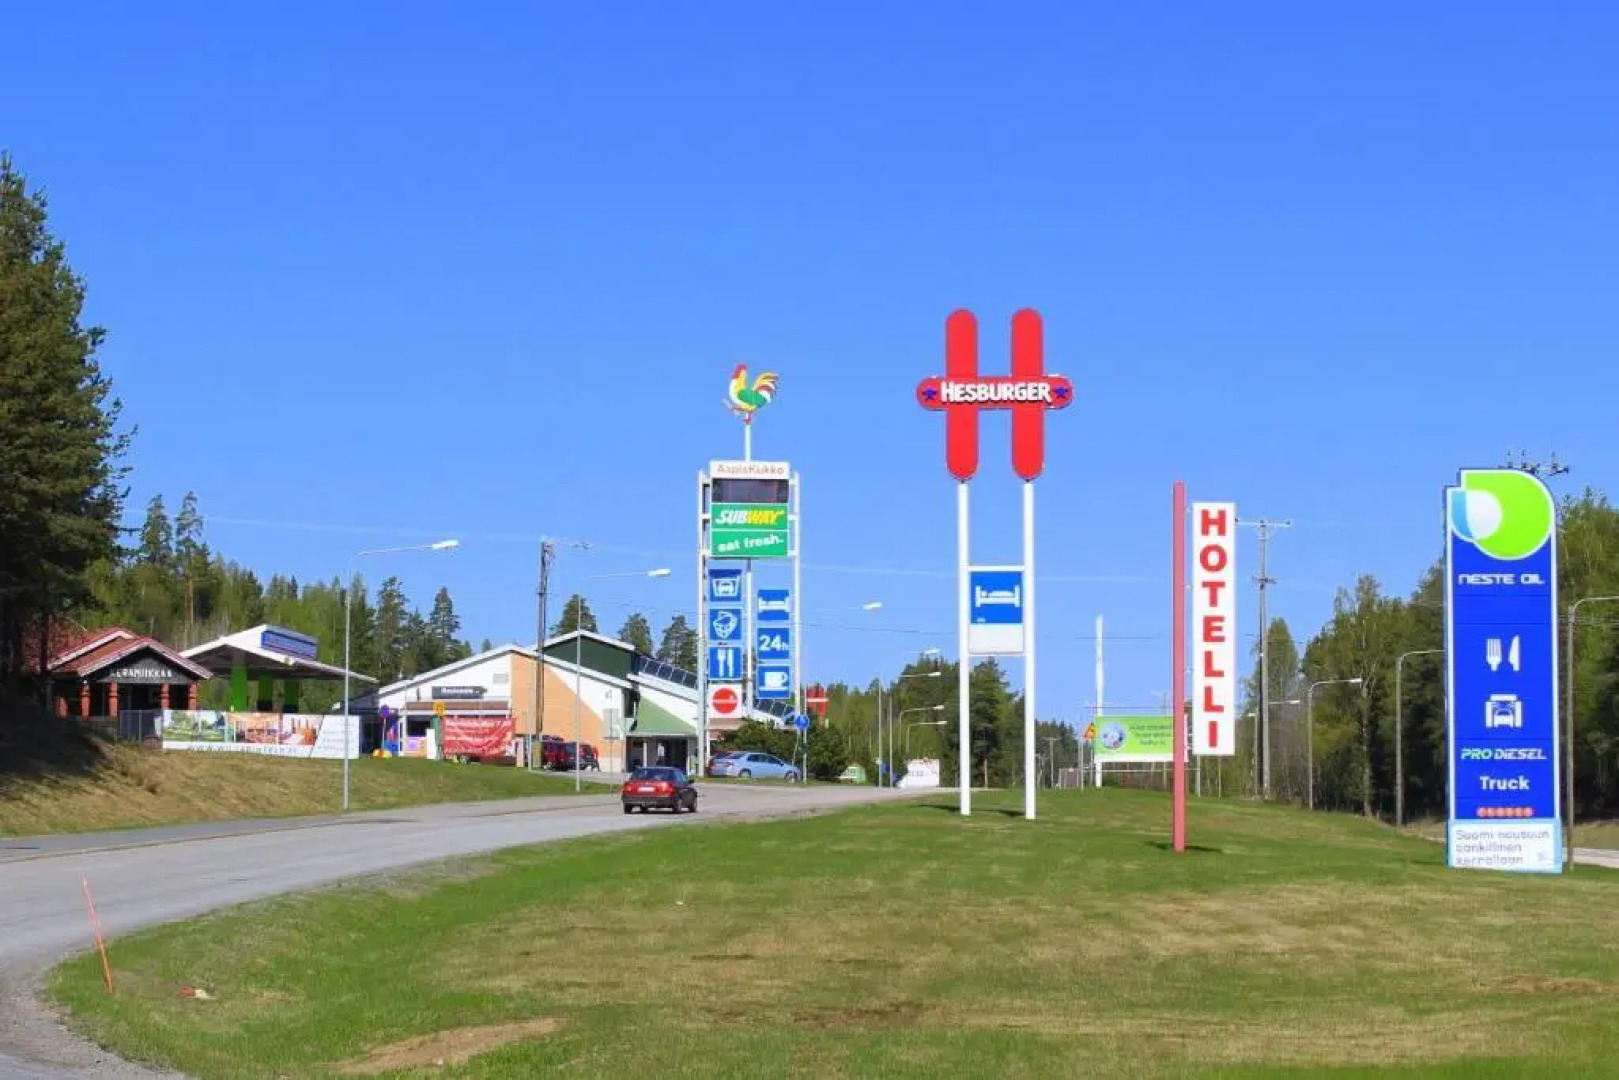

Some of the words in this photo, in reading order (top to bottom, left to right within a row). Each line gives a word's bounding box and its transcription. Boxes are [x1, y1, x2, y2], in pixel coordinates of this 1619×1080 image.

[941, 381, 1052, 402] HESBURGER
[715, 508, 784, 525] SUBWAY
[718, 540, 741, 552] eat
[1458, 573, 1516, 585] NESTE
[1520, 573, 1545, 585] OIL
[1199, 508, 1228, 748] HOTELLI
[758, 634, 789, 651] 24h
[1460, 747, 1493, 760] PRO
[1493, 747, 1547, 760] DIESEL
[1479, 775, 1530, 790] Truck
[1455, 829, 1494, 840] Suomi
